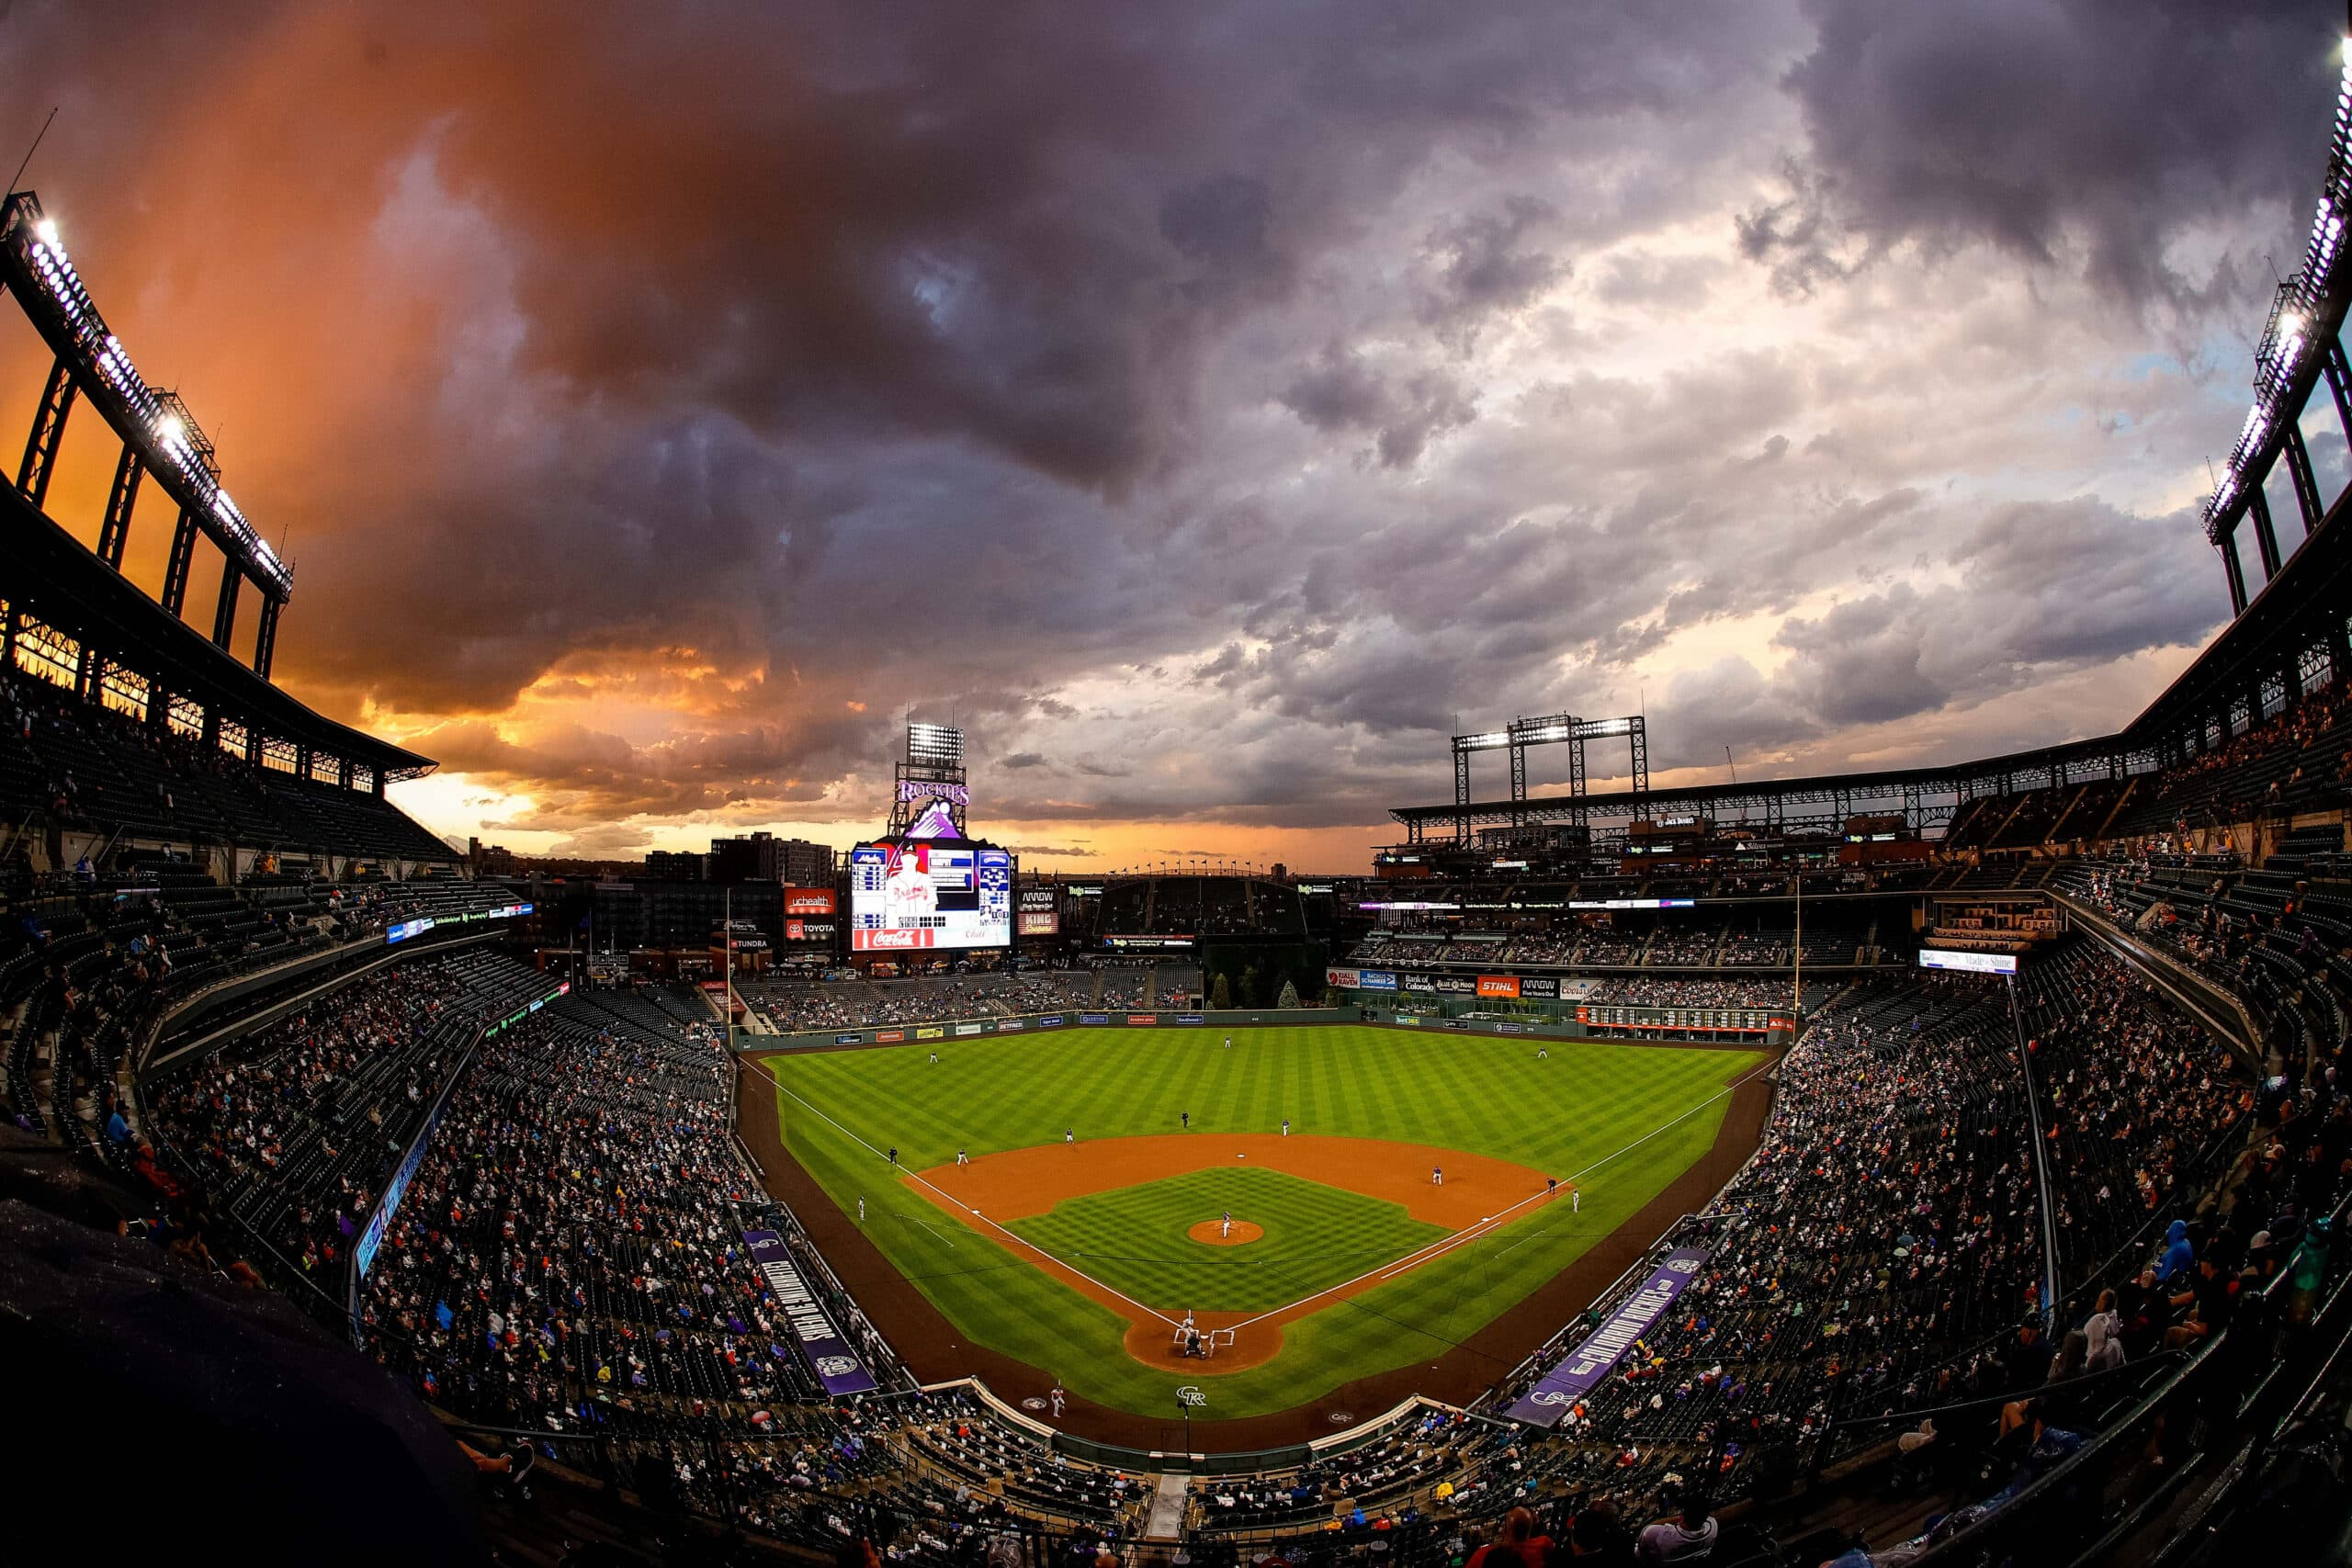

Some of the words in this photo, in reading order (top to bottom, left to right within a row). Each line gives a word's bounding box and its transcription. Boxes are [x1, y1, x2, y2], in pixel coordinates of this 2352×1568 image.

[898, 781, 970, 806] ROCKIES
[792, 896, 829, 906] uchealth
[1025, 914, 1052, 924] KING
[804, 924, 835, 932] TOYOTA
[873, 931, 915, 947] Coca-Cola
[1405, 975, 1420, 983] Bank
[1421, 975, 1429, 983] of
[1436, 979, 1451, 987] BLUE
[1405, 982, 1434, 991] Colorado
[1482, 982, 1513, 991] STIHL
[1561, 985, 1584, 995] Coors
[1396, 1016, 1419, 1025] bet365
[761, 1260, 813, 1304] CELEBRATING
[785, 1303, 820, 1315] 30
[791, 1314, 837, 1341] YEARS
[1577, 1317, 1645, 1365] COLORADO
[1620, 1289, 1674, 1322] ROCKIES
[1176, 1385, 1207, 1406] CR
